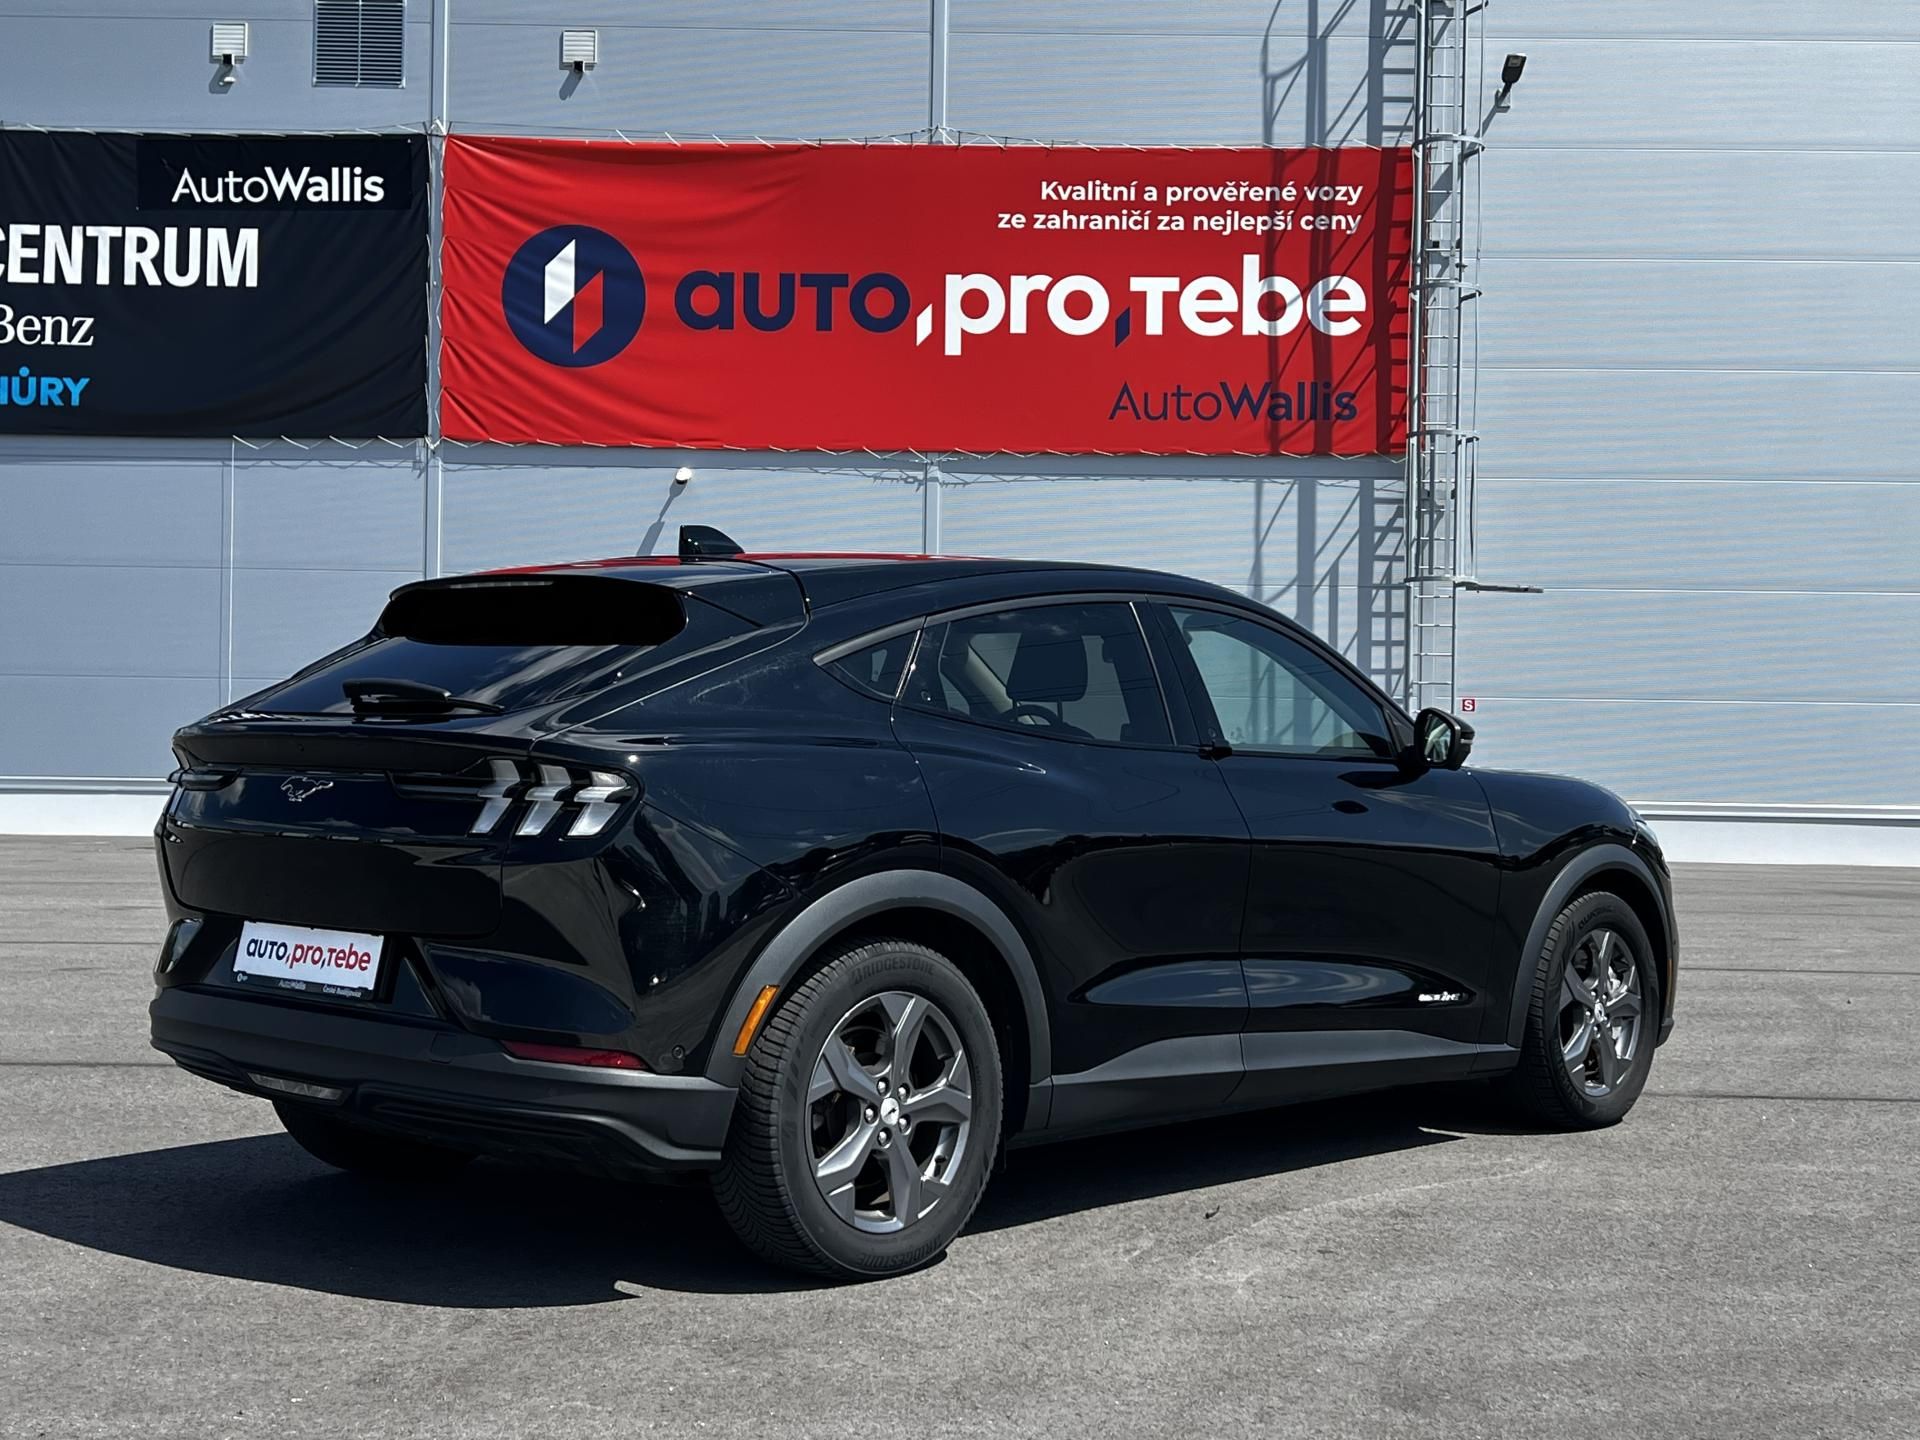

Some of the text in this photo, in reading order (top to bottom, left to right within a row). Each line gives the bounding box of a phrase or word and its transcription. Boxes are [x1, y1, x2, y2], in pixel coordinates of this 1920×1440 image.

[171, 166, 385, 203] AutoWallis
[1041, 180, 1363, 206] Kvalitní a prověřené vozy
[997, 209, 1362, 235] ze zahraničí za nejlepší ceny
[0, 223, 259, 288] ENTRUM
[1108, 381, 1357, 422] AutoWallis
[1463, 699, 1474, 711] S
